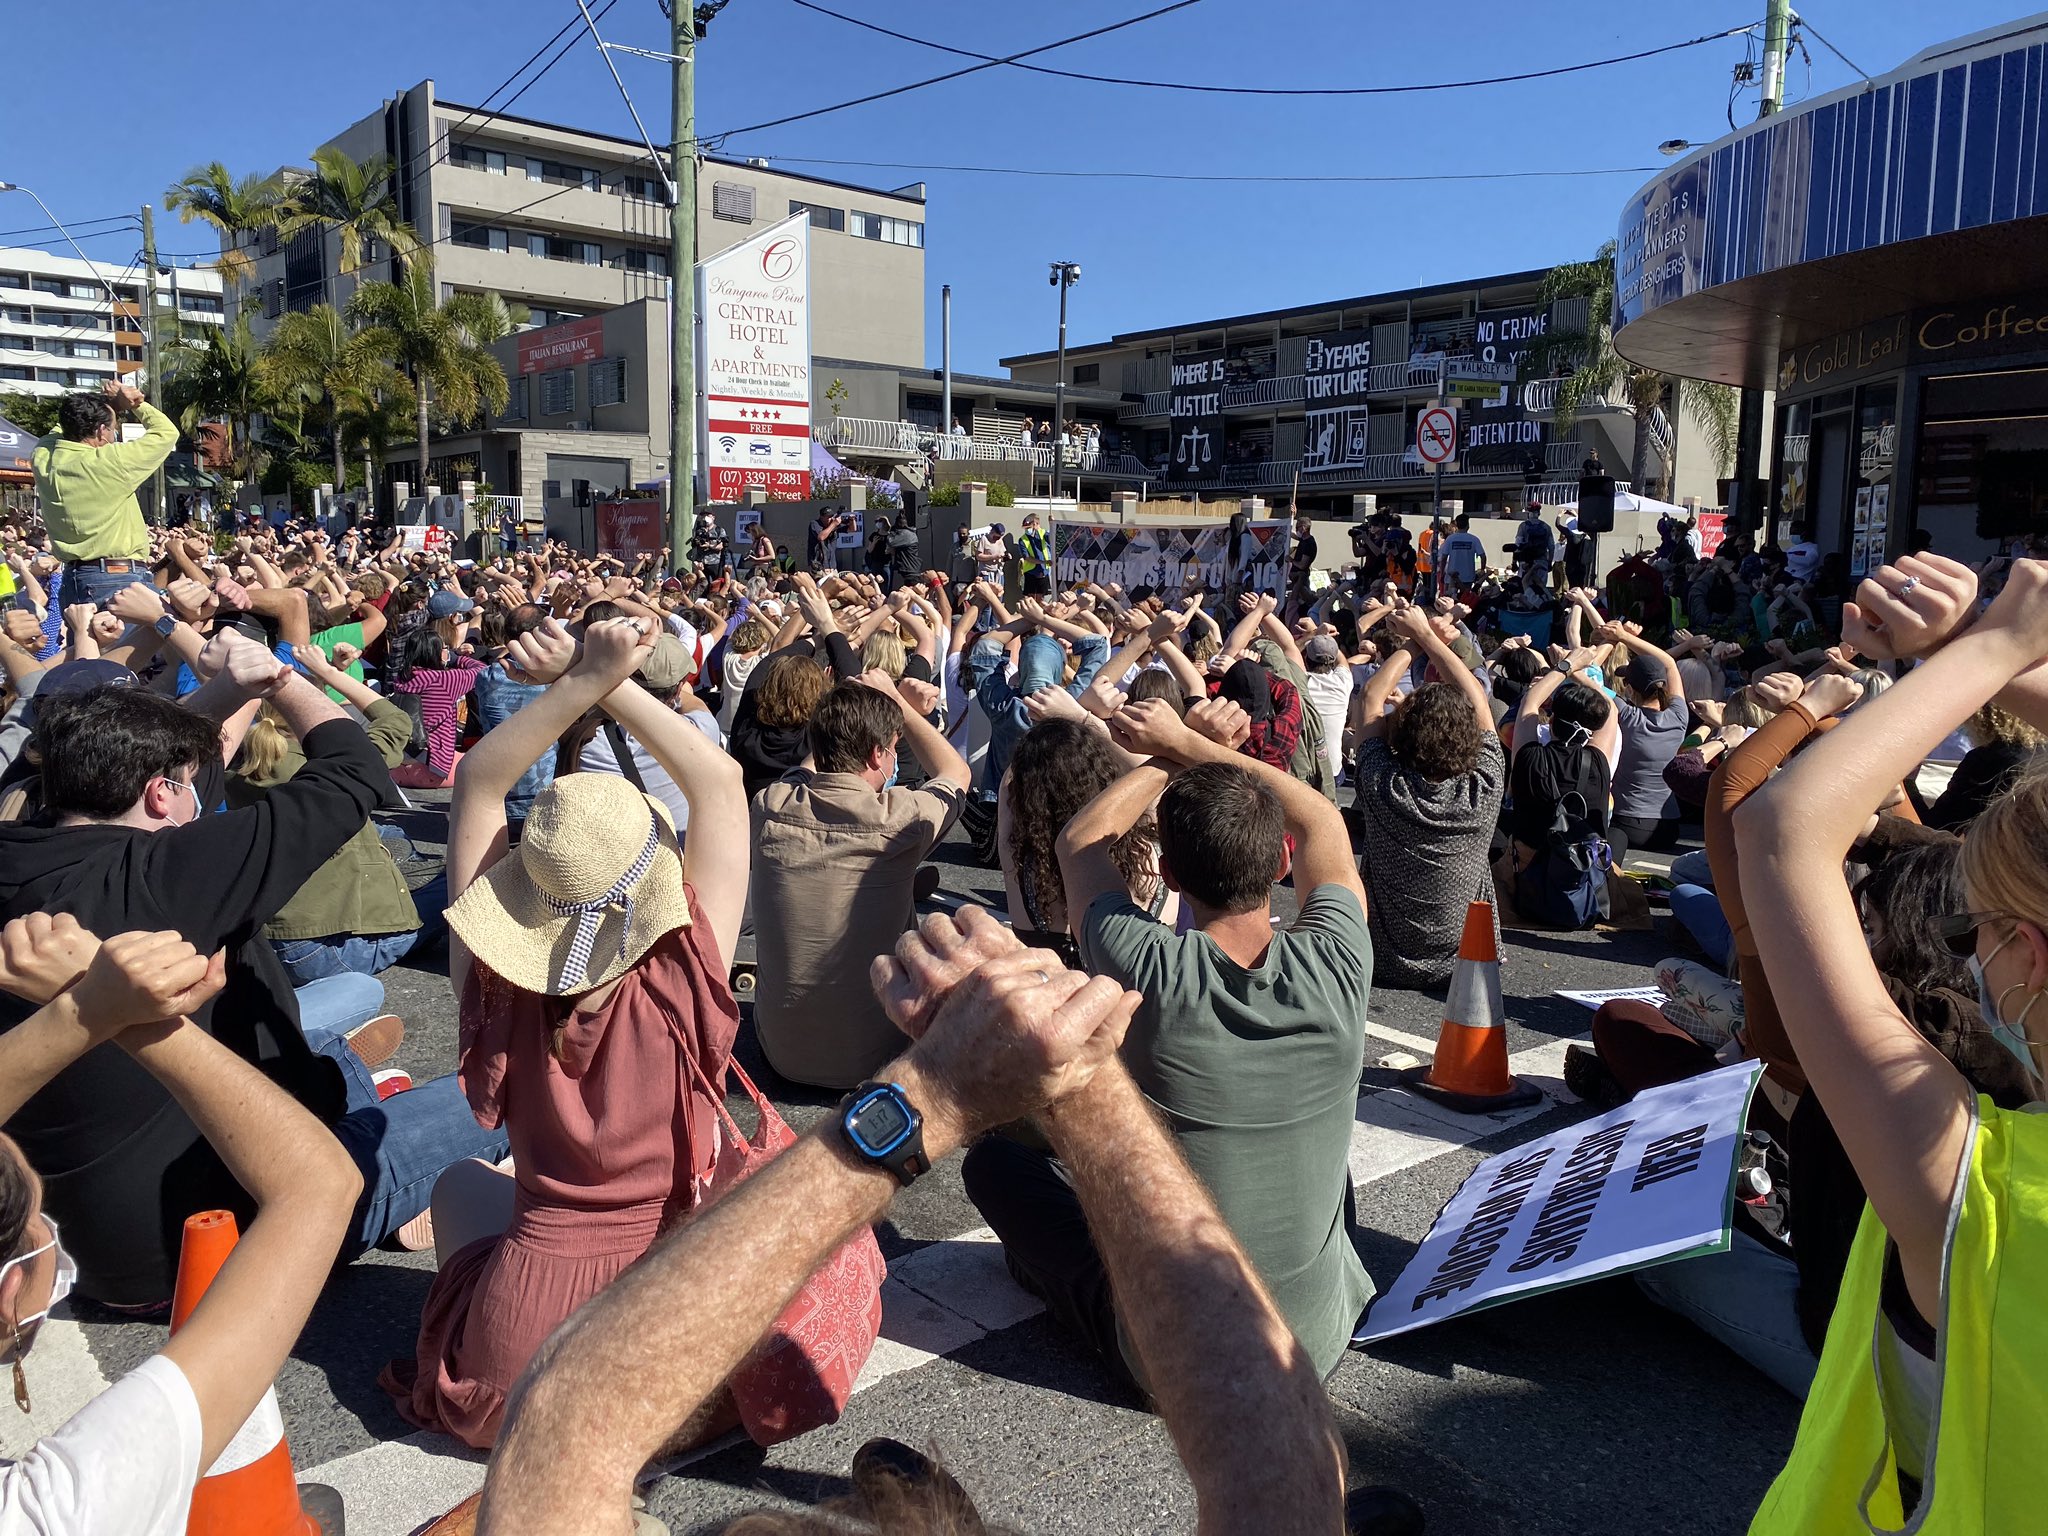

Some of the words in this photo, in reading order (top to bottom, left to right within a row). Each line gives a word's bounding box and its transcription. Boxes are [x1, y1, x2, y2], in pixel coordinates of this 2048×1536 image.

[1638, 224, 1688, 264] PLANNERS
[1640, 255, 1686, 294] DESIGNERS
[709, 276, 769, 303] Kangaroo
[771, 285, 805, 305] Point
[718, 302, 798, 327] CENTRAL
[729, 323, 789, 345] HOTEL
[1477, 321, 1495, 342] NO
[1501, 313, 1548, 341] CRIME
[529, 346, 551, 361] ITALIAN
[551, 337, 589, 356] RESTAURANT
[753, 344, 764, 360] &
[1306, 339, 1324, 372] 8
[1324, 341, 1371, 370] YEARS
[1803, 332, 1851, 384] Gold
[1857, 315, 1909, 370] Leaf
[710, 358, 808, 380] APARTMENTS
[1171, 361, 1209, 386] WHERE
[1211, 358, 1225, 381] IS
[1461, 362, 1501, 374] WALMSLEY
[711, 384, 740, 395] Nightly,
[741, 386, 768, 397] Weekly
[768, 389, 775, 397] &
[776, 389, 805, 400] Monthly
[748, 378, 763, 386] Check
[1304, 368, 1369, 399] TORTURE
[1170, 392, 1219, 417] JUSTICE
[749, 423, 773, 434] FREE
[1469, 420, 1541, 447] DETENTION
[749, 457, 772, 466] Parking
[719, 469, 742, 486] (07)
[744, 470, 802, 486] 3391-2881
[719, 487, 738, 499] 721
[607, 505, 649, 531] Kangaroo
[615, 526, 640, 547] Point
[1057, 556, 1134, 588] HISTORY
[858, 1097, 878, 1114] GARMIN
[868, 1108, 889, 1130] 1:17
[1487, 1146, 1557, 1194] SAY
[1630, 1122, 1709, 1194] REAL
[1506, 1118, 1636, 1274] AUSTRALIANS
[1410, 1179, 1534, 1313] WELCOME
